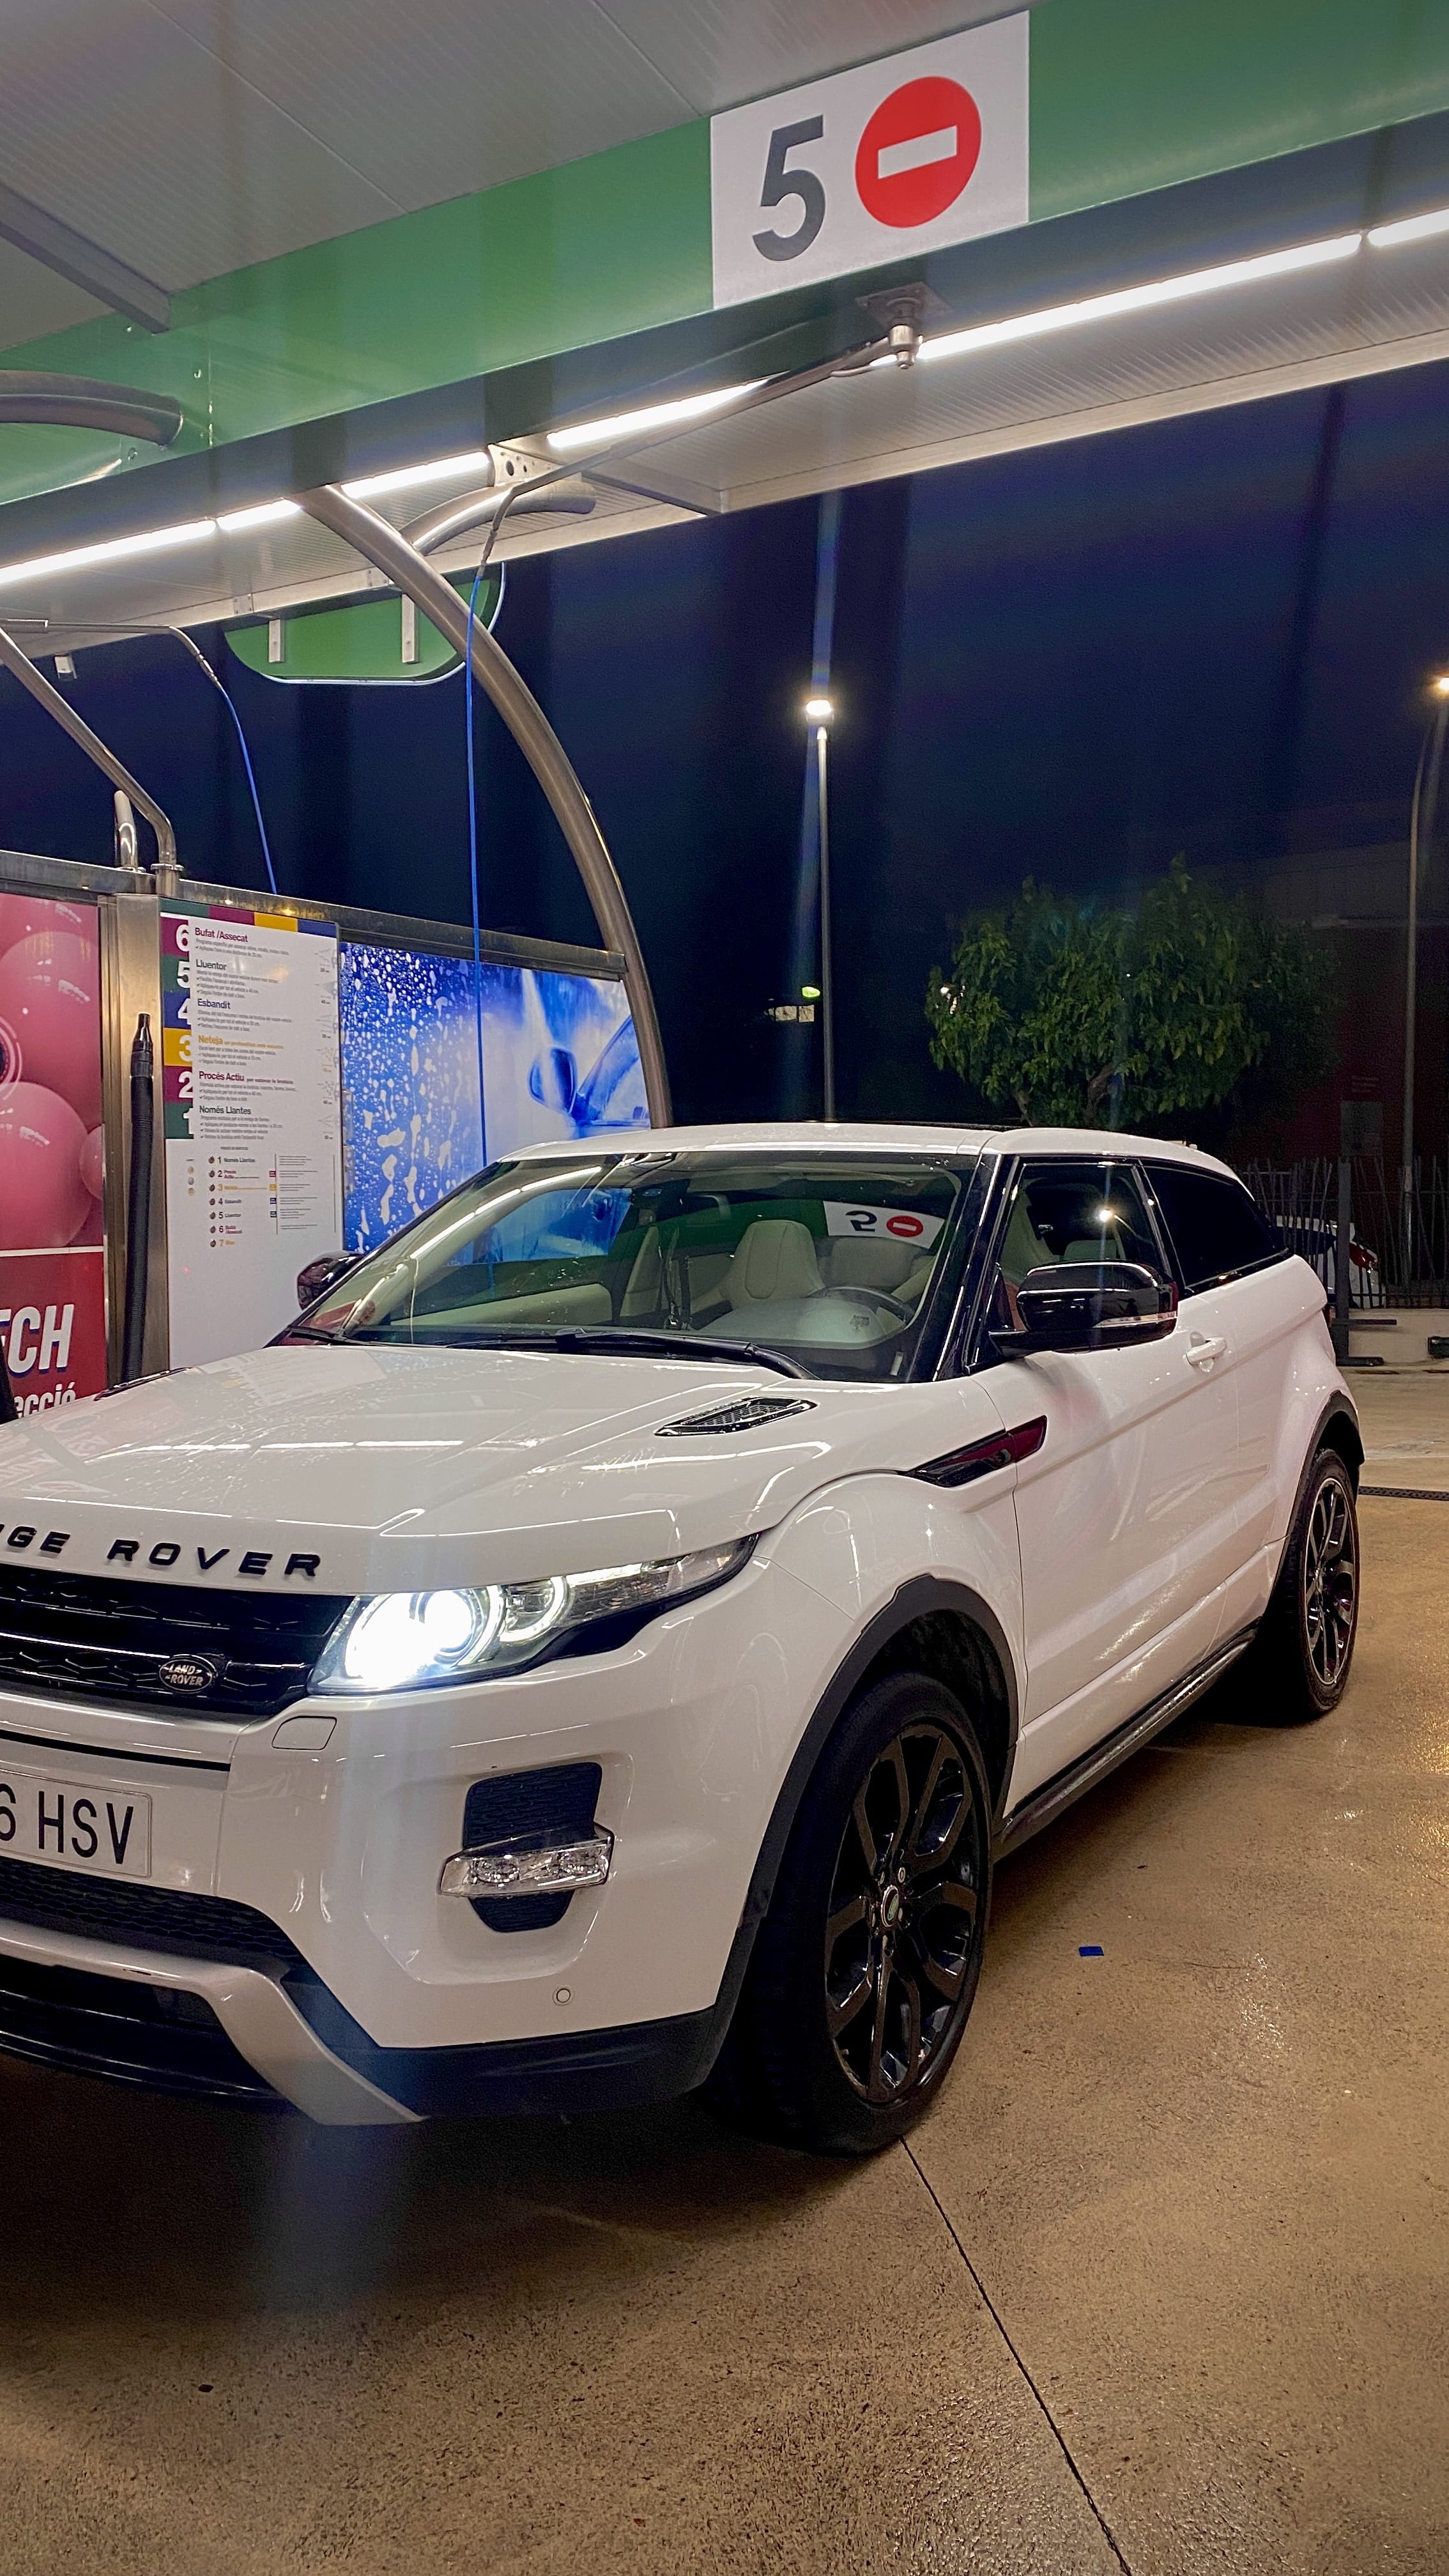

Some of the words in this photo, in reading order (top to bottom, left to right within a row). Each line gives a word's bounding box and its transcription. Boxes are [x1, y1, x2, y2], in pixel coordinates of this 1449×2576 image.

[752, 114, 825, 261] 5
[176, 924, 190, 952] 6
[195, 928, 215, 938] Bufat
[177, 961, 190, 988] 5
[195, 959, 227, 970] Lluentor
[178, 998, 191, 1025] 4
[197, 998, 231, 1009] Esbandit
[179, 1034, 192, 1062] 3
[198, 1035, 223, 1045] Neteja
[178, 1071, 193, 1098] 2
[199, 1071, 224, 1081] Procés
[226, 1073, 244, 1082] Actiu
[183, 1107, 194, 1135] 1
[199, 1105, 224, 1114] Només
[226, 1106, 251, 1115] Llantes
[0, 1524, 70, 1554] GE
[107, 1539, 321, 1577] ROVER
[168, 1663, 196, 1675] LAND
[170, 1673, 204, 1687] ROVER
[38, 1791, 134, 1864] HSV
